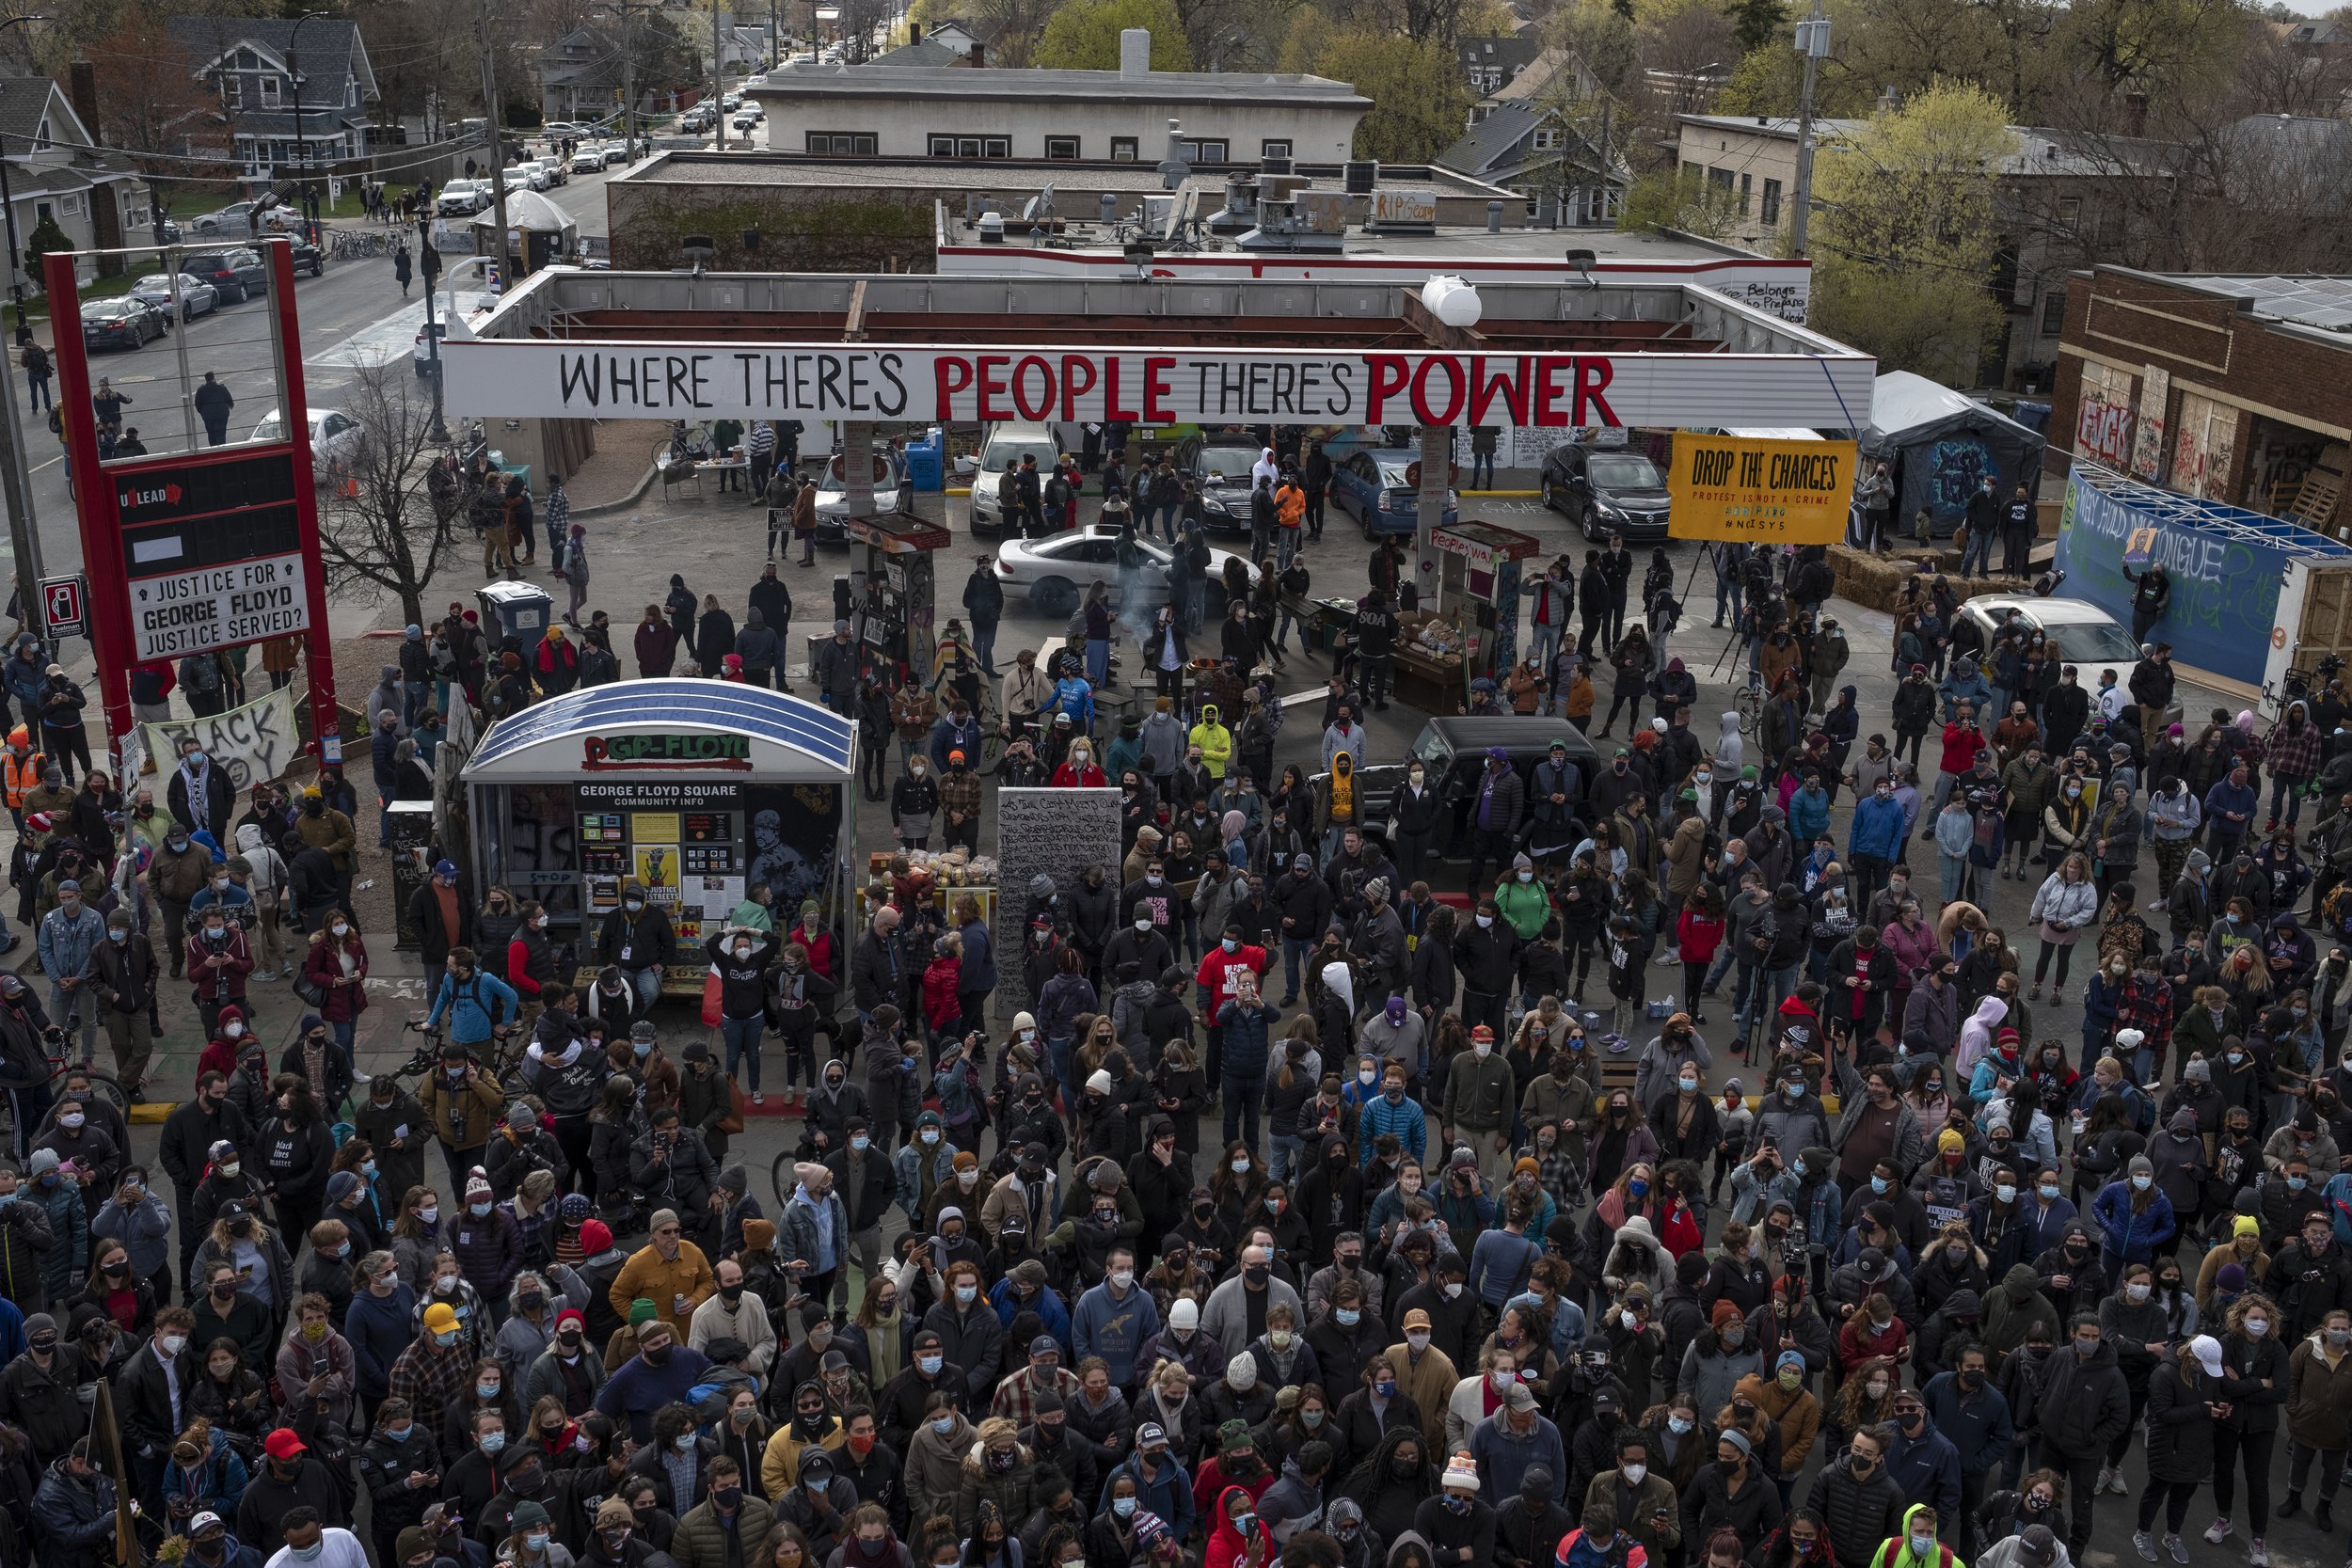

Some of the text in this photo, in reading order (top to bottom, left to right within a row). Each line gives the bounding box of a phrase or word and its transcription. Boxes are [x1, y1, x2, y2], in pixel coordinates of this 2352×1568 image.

[1747, 283, 1795, 298] Belongs
[1763, 296, 1805, 311] Prepare
[560, 350, 1624, 427] WHERE THERE'S PEOPLE THERE'S POWER
[875, 466, 882, 474] 3
[1410, 470, 1417, 480] 2
[1692, 450, 1837, 491] DROP THE CHARGES
[1692, 491, 1736, 503] PROTEST
[1782, 495, 1788, 503] A
[1795, 496, 1829, 505] CRIME
[2154, 524, 2227, 584] TONGUE
[157, 563, 275, 602] JUSTICE FOR
[144, 586, 292, 631] GEORGE FLOYD
[1359, 611, 1387, 627] SOA
[51, 624, 81, 633] Fuelman
[147, 608, 303, 656] JUSTICE SERVED?
[123, 733, 136, 750] TRUCK
[580, 785, 737, 797] GEORGE FLOYD SQUARE
[614, 798, 704, 806] COMMUNITY INFO
[394, 839, 423, 851] REST
[530, 872, 571, 884] STOP
[1825, 907, 1849, 916] BLACK
[276, 1140, 294, 1149] black
[273, 1149, 290, 1158] lives
[1136, 1514, 1162, 1537] TWINS
